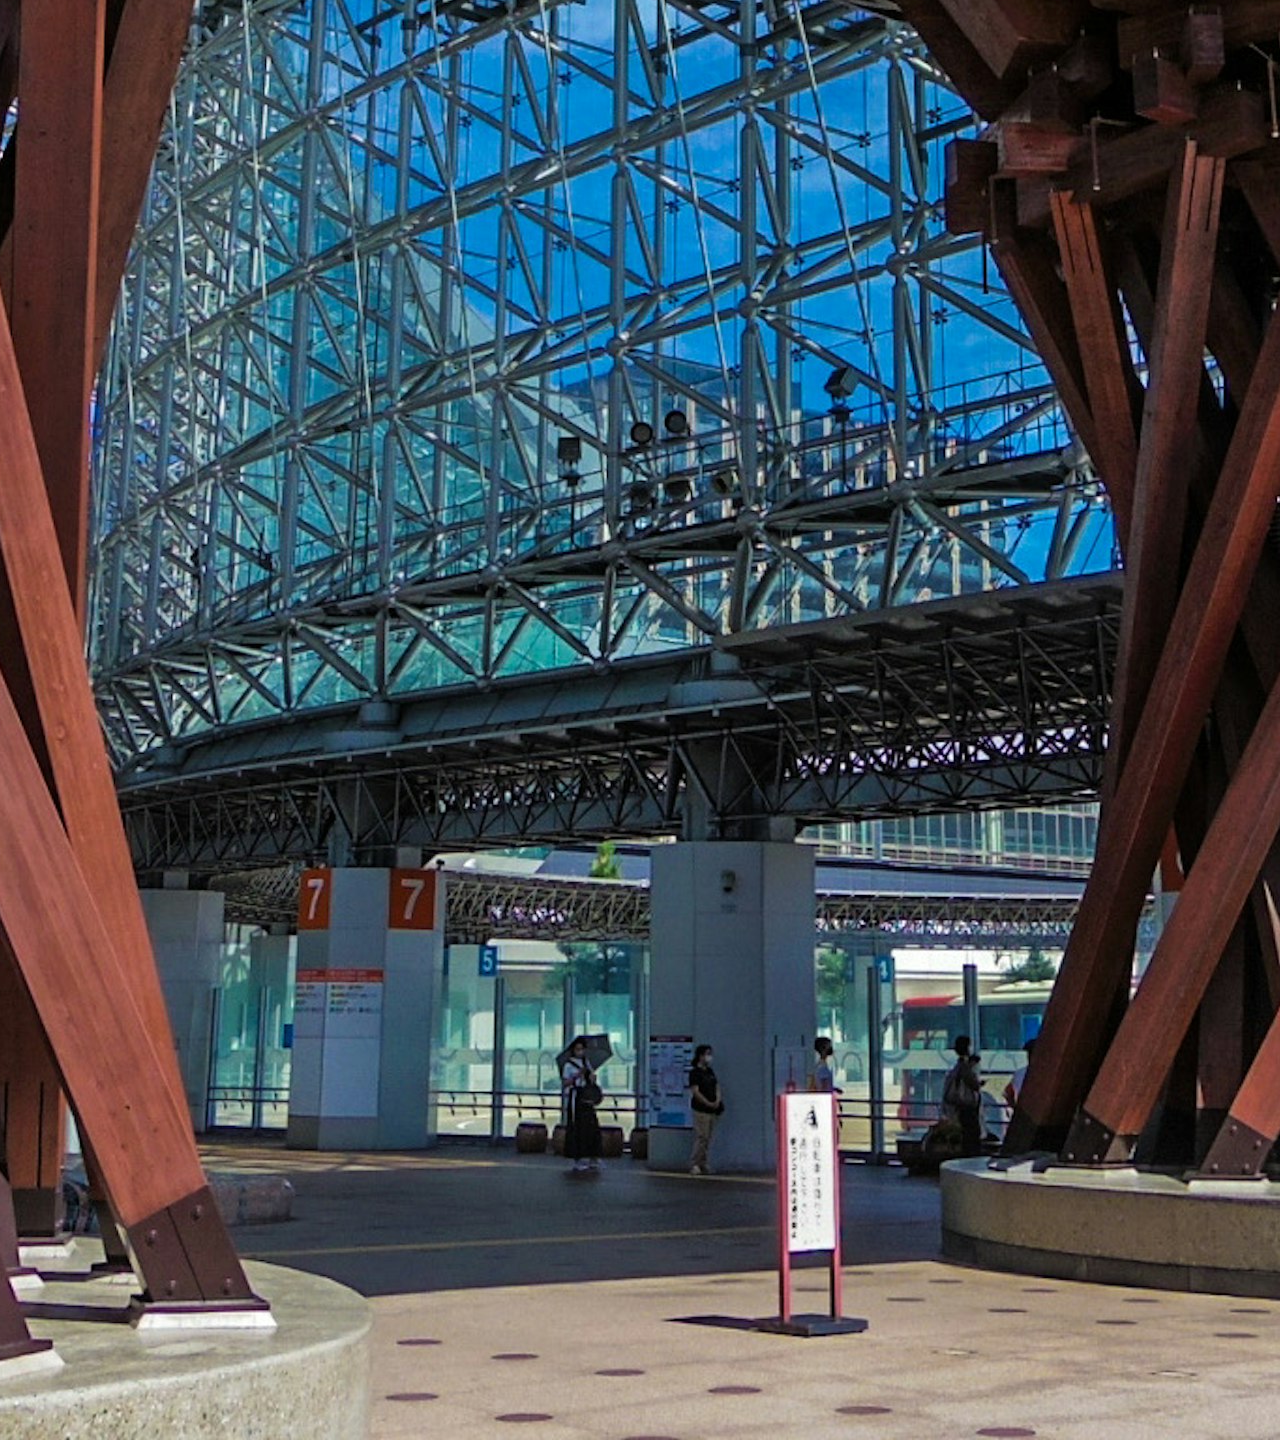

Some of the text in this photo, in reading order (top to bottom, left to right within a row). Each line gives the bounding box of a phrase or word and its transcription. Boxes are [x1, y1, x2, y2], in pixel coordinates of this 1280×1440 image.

[306, 878, 325, 921] 7
[400, 878, 426, 921] 7
[482, 949, 494, 972] 5
